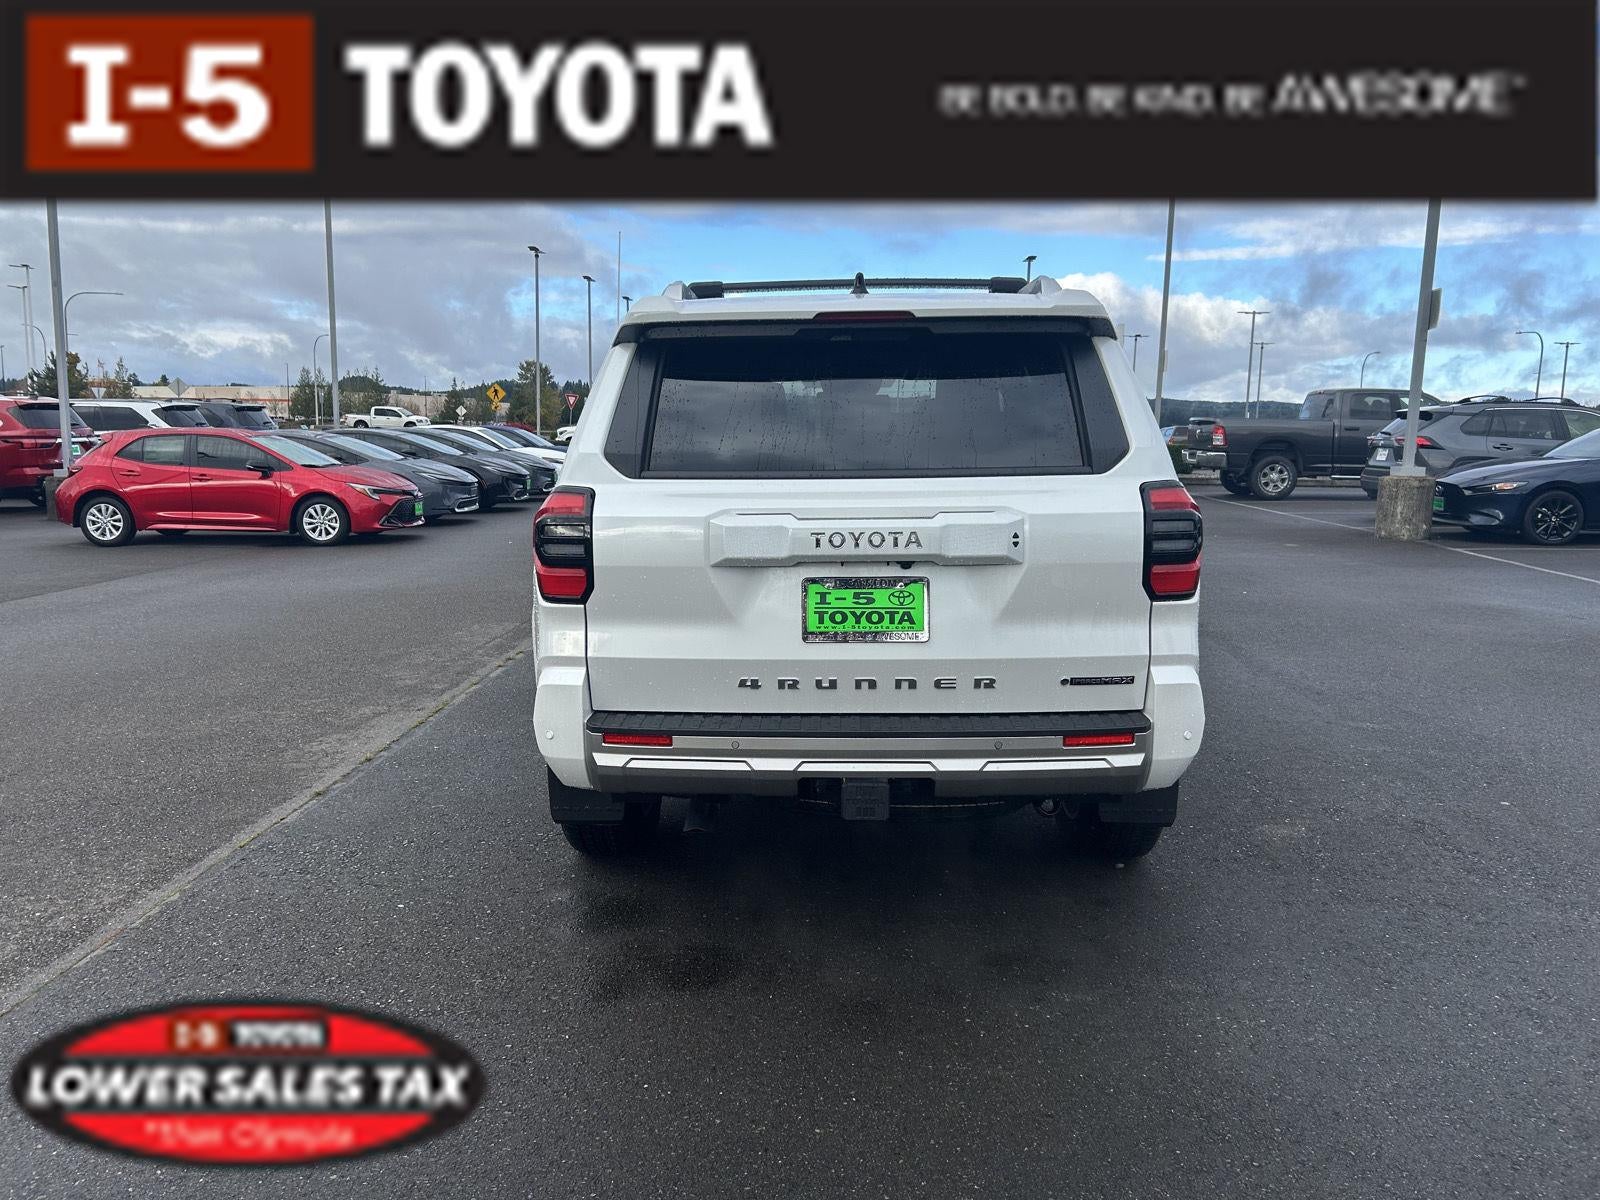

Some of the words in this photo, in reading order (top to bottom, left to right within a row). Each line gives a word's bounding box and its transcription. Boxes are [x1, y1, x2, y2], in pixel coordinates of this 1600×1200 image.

[810, 531, 923, 549] TOYOTA
[814, 591, 876, 606] I-5
[813, 610, 917, 625] TOYOTA
[737, 676, 998, 690] 4RUNNER
